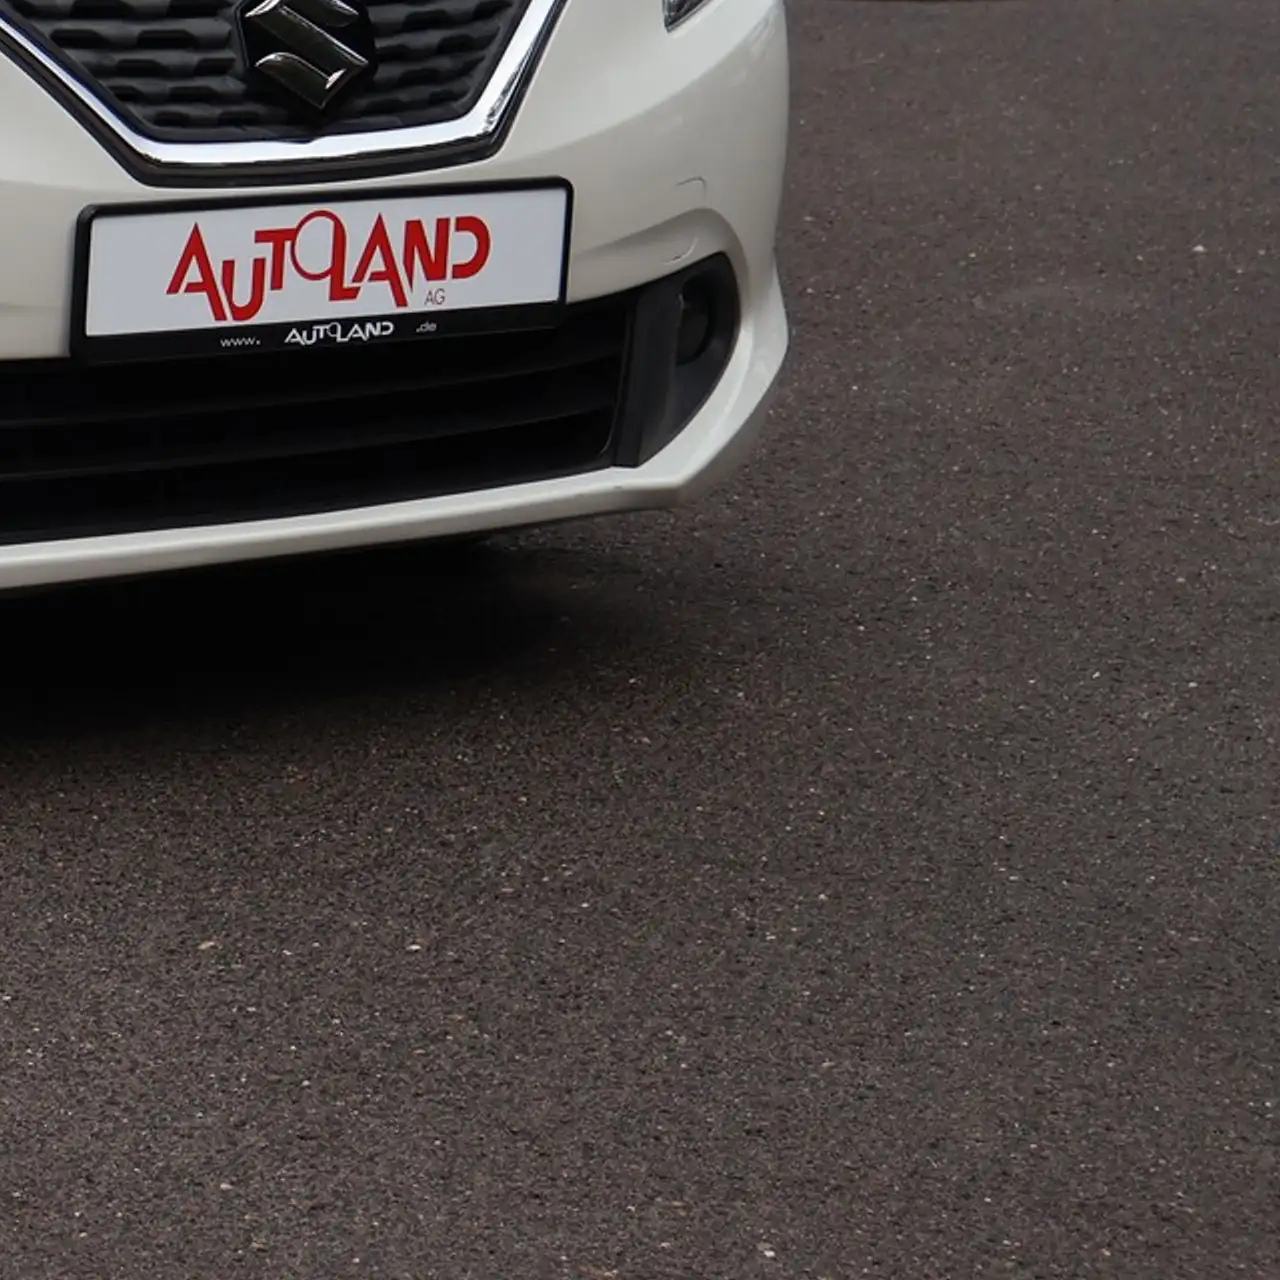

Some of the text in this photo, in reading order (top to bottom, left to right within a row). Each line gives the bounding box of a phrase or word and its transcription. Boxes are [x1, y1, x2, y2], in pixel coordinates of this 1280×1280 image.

[166, 209, 492, 321] AUTOLAND
[424, 287, 446, 305] AG
[220, 336, 261, 347] www.
